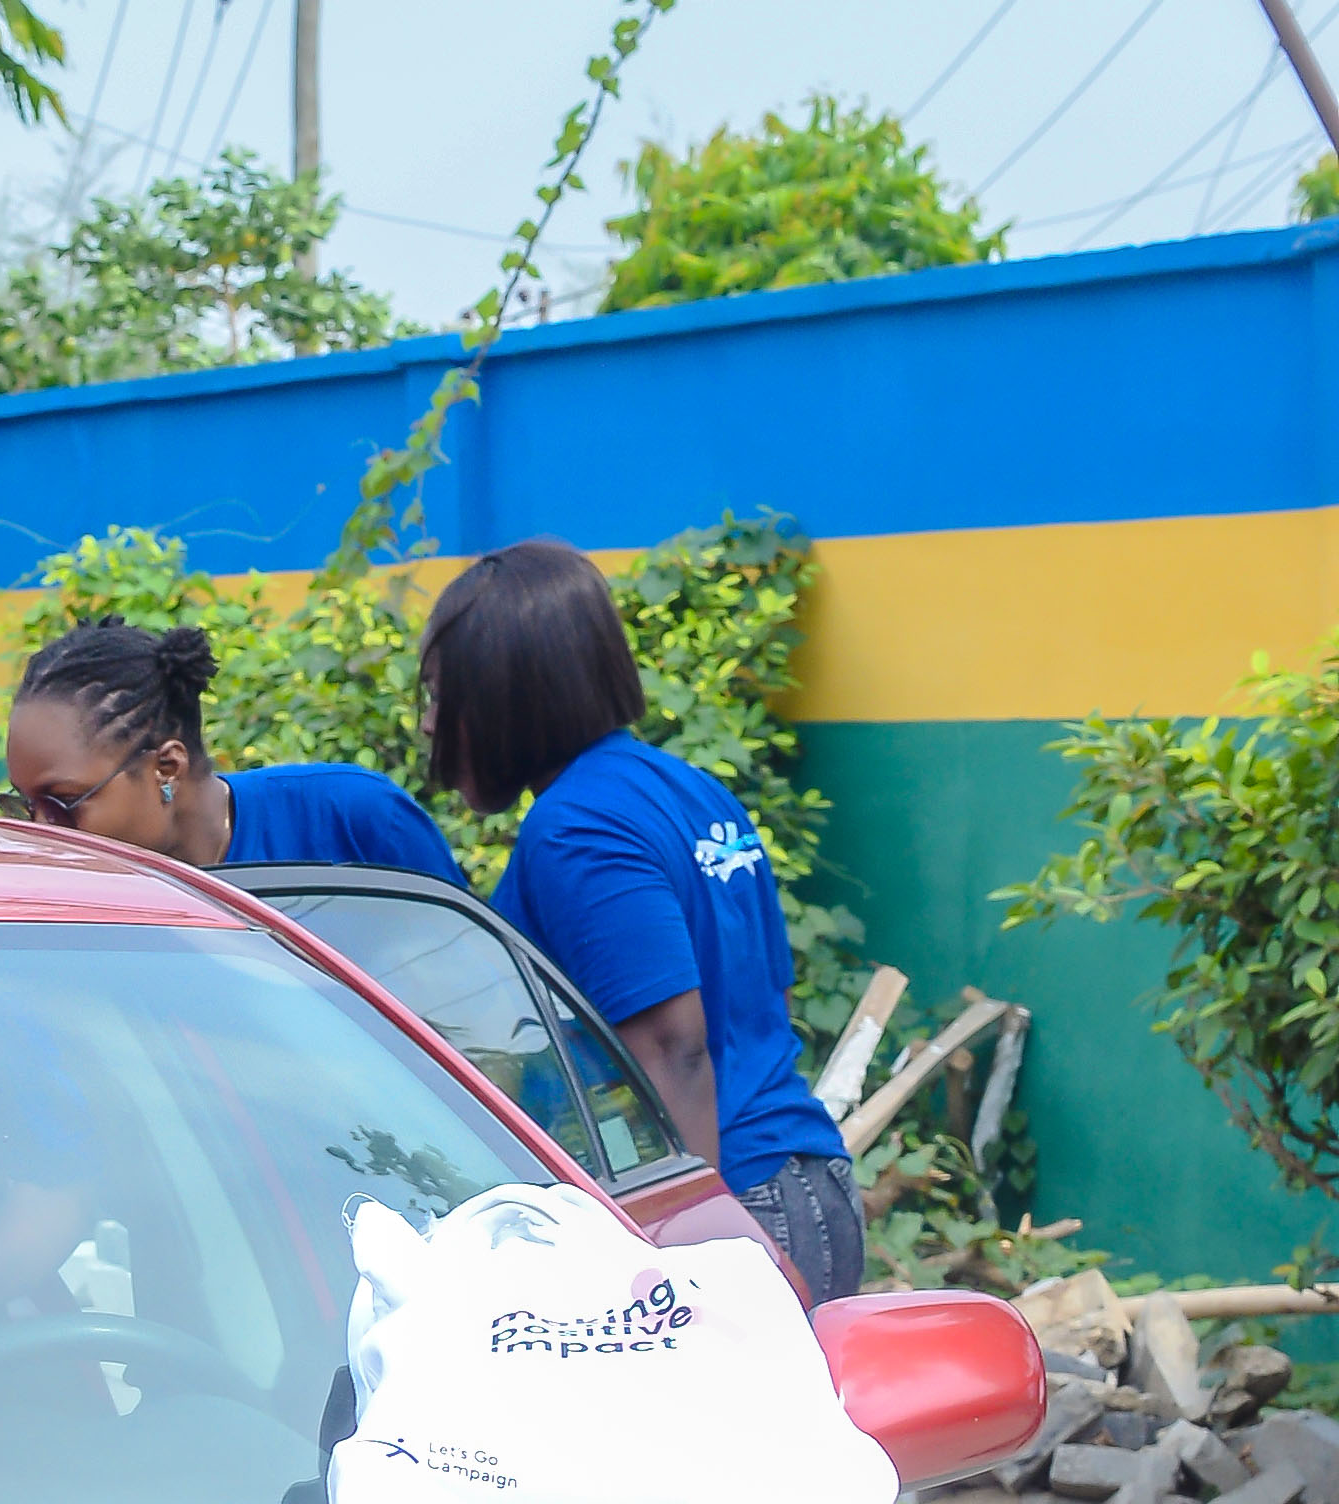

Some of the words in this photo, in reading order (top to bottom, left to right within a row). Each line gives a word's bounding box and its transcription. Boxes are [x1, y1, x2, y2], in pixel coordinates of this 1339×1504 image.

[491, 1279, 676, 1328] ming
[491, 1337, 678, 1358] impact
[474, 1450, 498, 1466] Go
